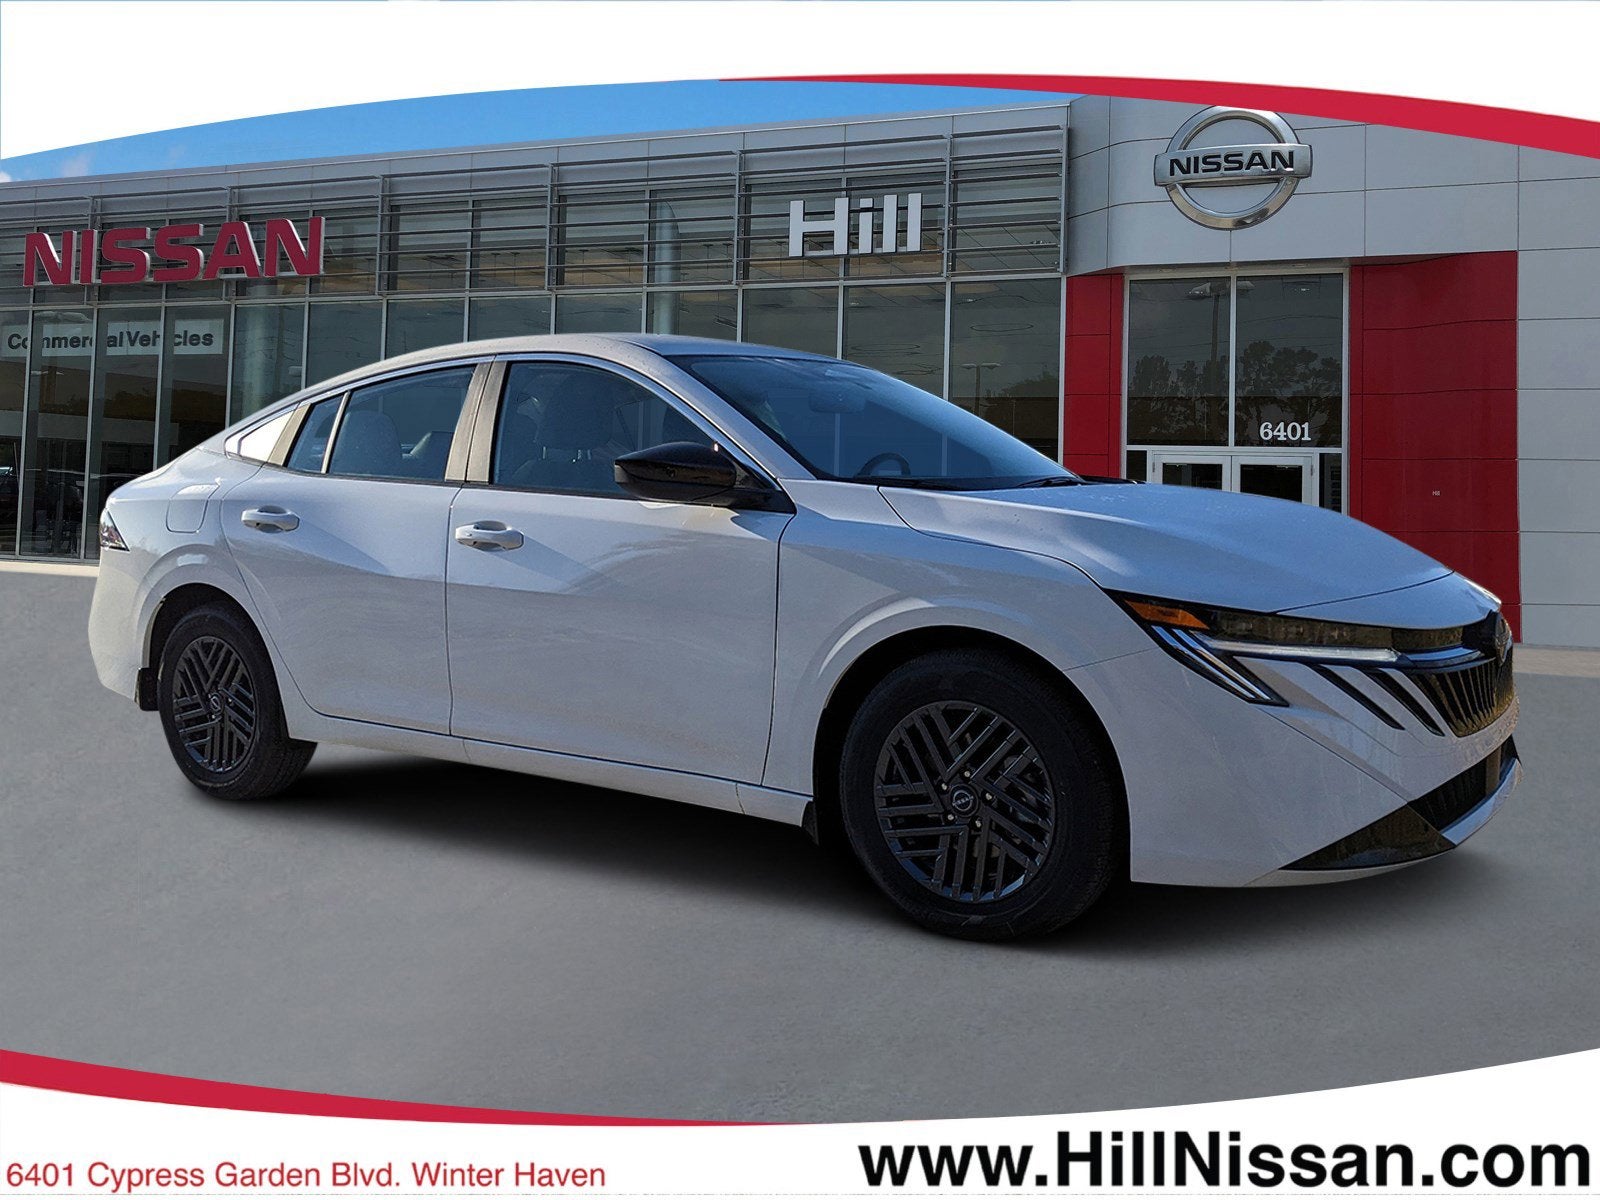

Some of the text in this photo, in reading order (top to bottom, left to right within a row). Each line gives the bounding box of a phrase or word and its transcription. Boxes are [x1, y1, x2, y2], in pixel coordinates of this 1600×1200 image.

[1169, 150, 1294, 176] NISSAN
[788, 192, 922, 257] Hill
[23, 216, 325, 287] NISSAN
[7, 330, 214, 350] Comeral Vehcles
[1259, 421, 1312, 441] 6401
